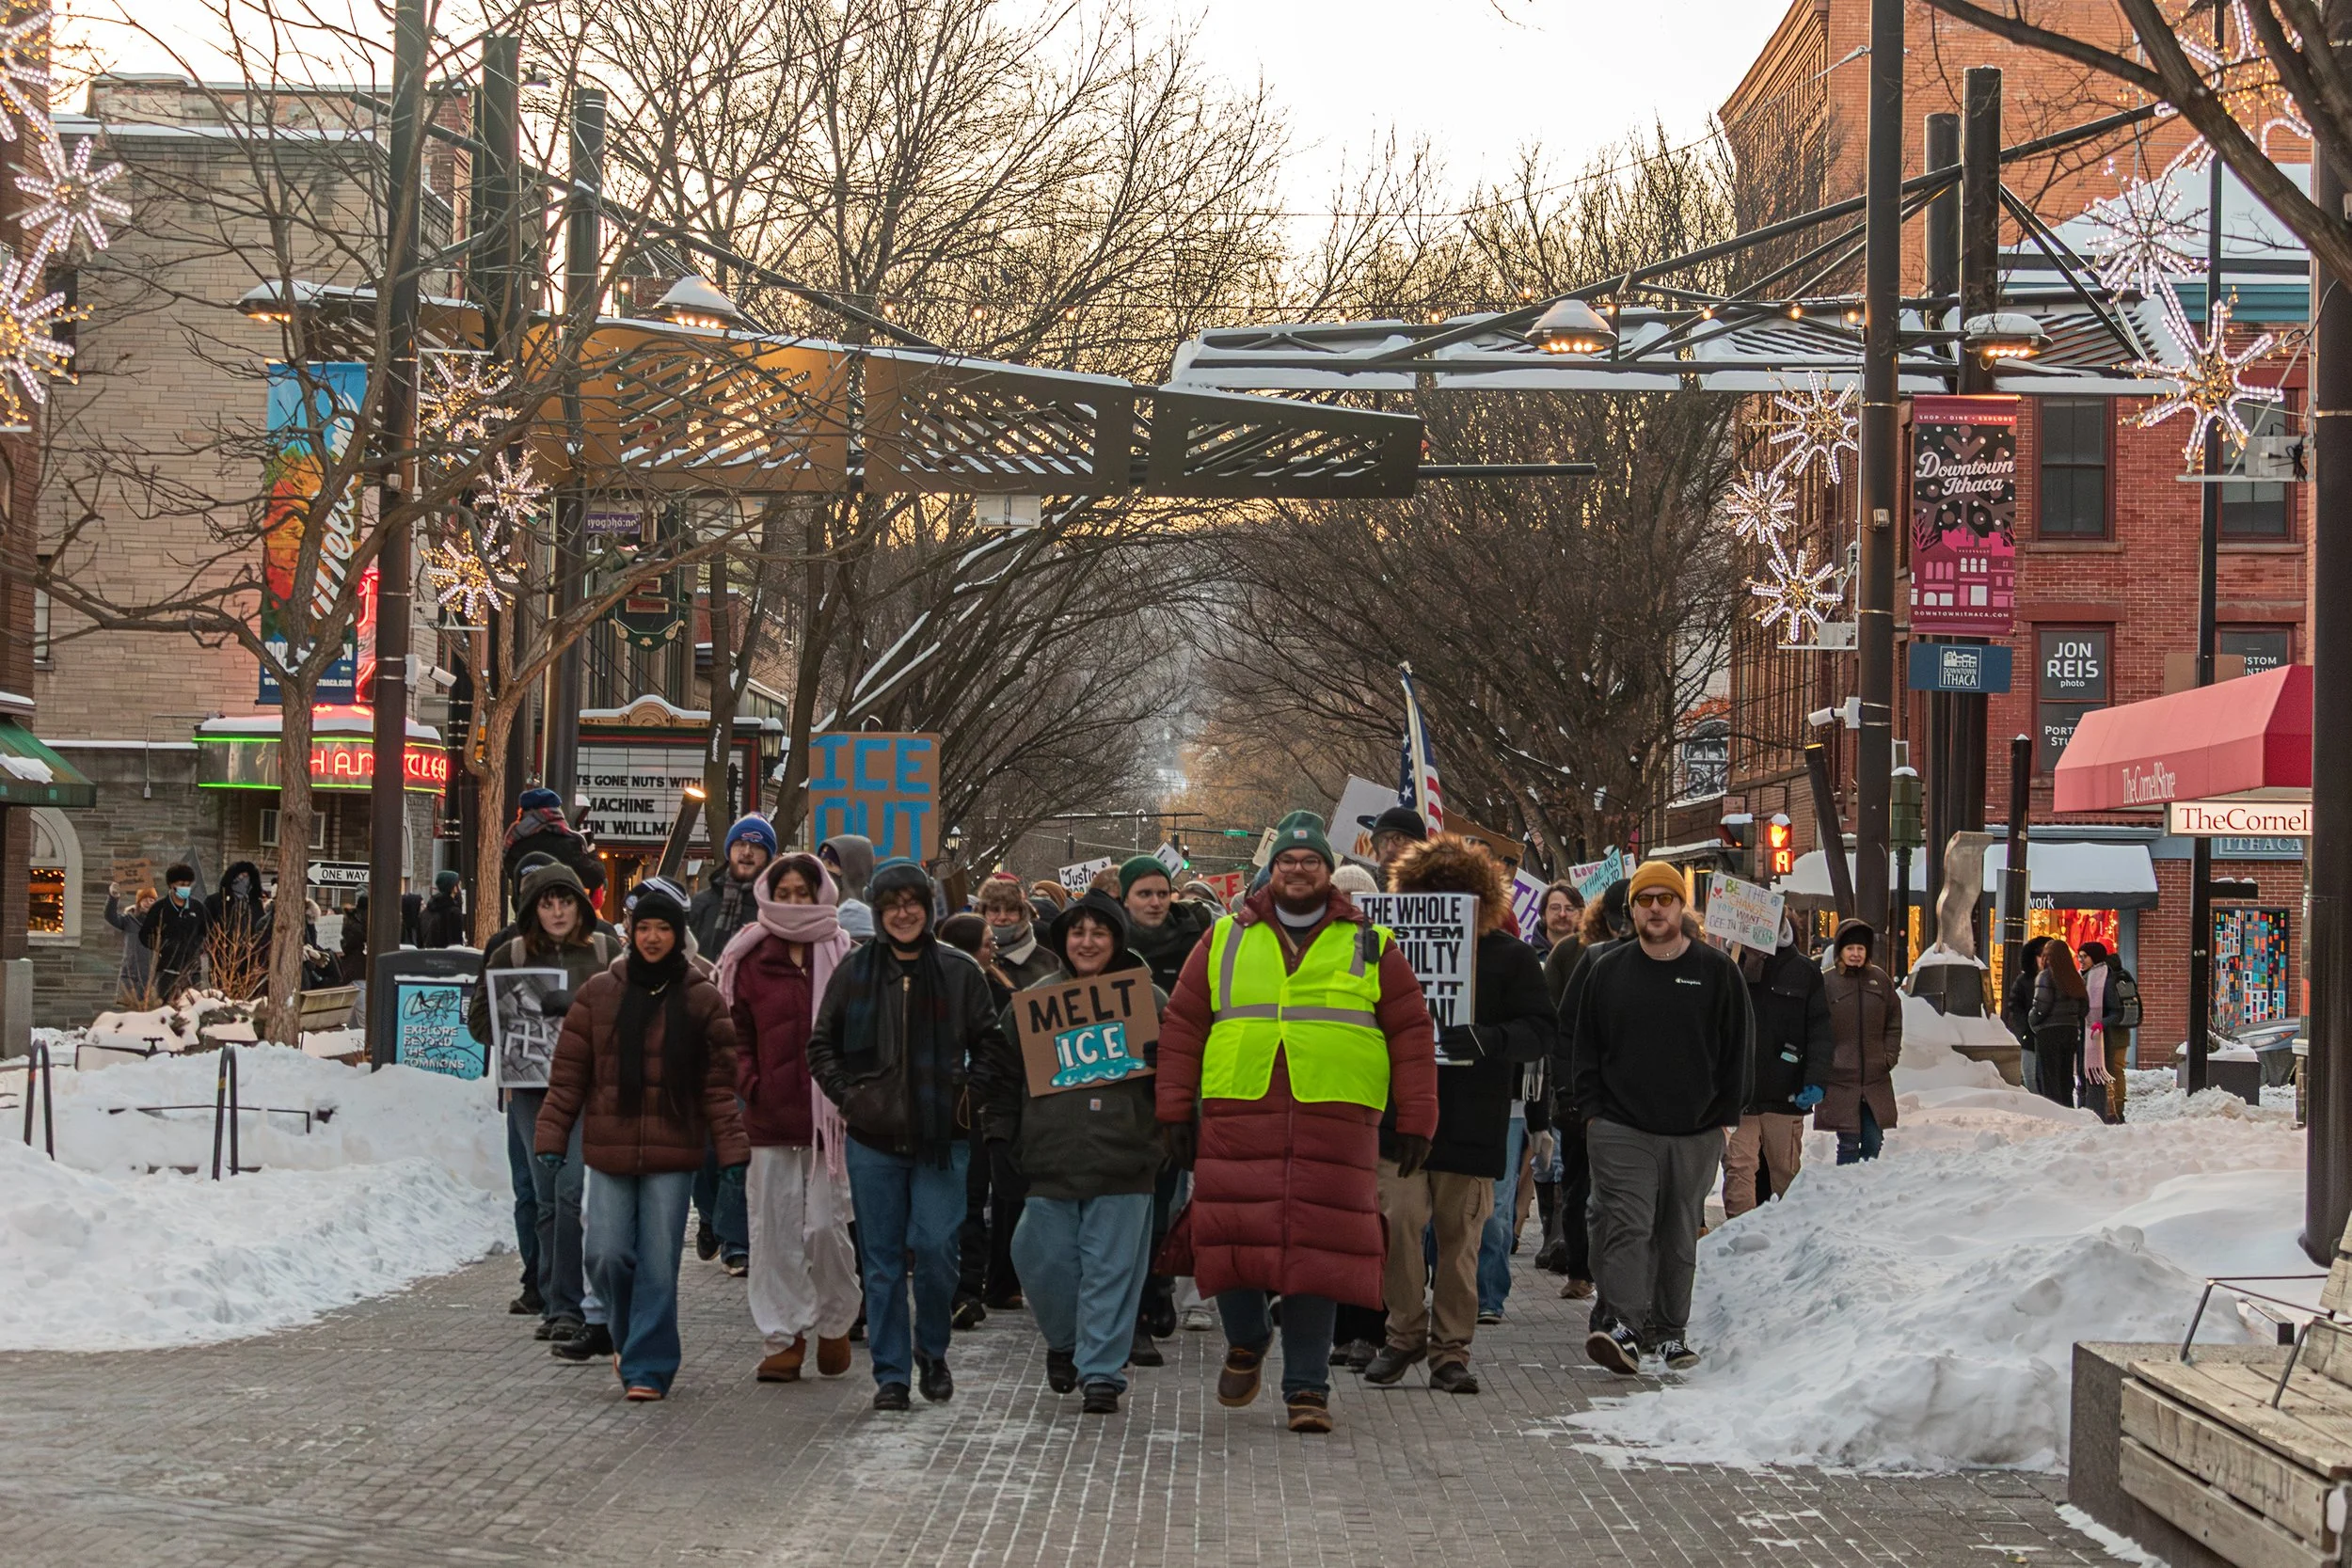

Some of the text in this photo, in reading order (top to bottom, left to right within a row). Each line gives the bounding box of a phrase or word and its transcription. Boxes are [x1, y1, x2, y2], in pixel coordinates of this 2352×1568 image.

[1915, 451, 2015, 478] Downtown
[1941, 476, 2005, 496] Ithaca
[2054, 641, 2092, 658] JON
[2243, 657, 2277, 665] STOM
[1943, 667, 1978, 675] DOWNTOWN
[2046, 659, 2099, 678] REIS
[1943, 673, 1977, 687] ITHACA
[2059, 679, 2086, 689] photo
[2044, 725, 2076, 736] PORT
[2051, 736, 2071, 747] STU
[809, 735, 932, 794] ICE
[577, 774, 701, 788] TS GONE NUTS WITH
[589, 797, 655, 813] MACHINE
[2179, 807, 2312, 831] TheCornel
[583, 820, 674, 835] TIN WILLM
[2225, 837, 2303, 850] ITHACA
[322, 869, 367, 880] ONE WAY
[1725, 879, 1767, 905] BE THE
[2029, 894, 2055, 910] work
[1361, 896, 1462, 924] THE WHOLE
[1392, 926, 1465, 940] STEM
[1028, 978, 1136, 1034] MELT
[404, 1025, 459, 1037] EXPLORE
[404, 1036, 453, 1047] BEYOND
[403, 1058, 466, 1069] COMMONS
